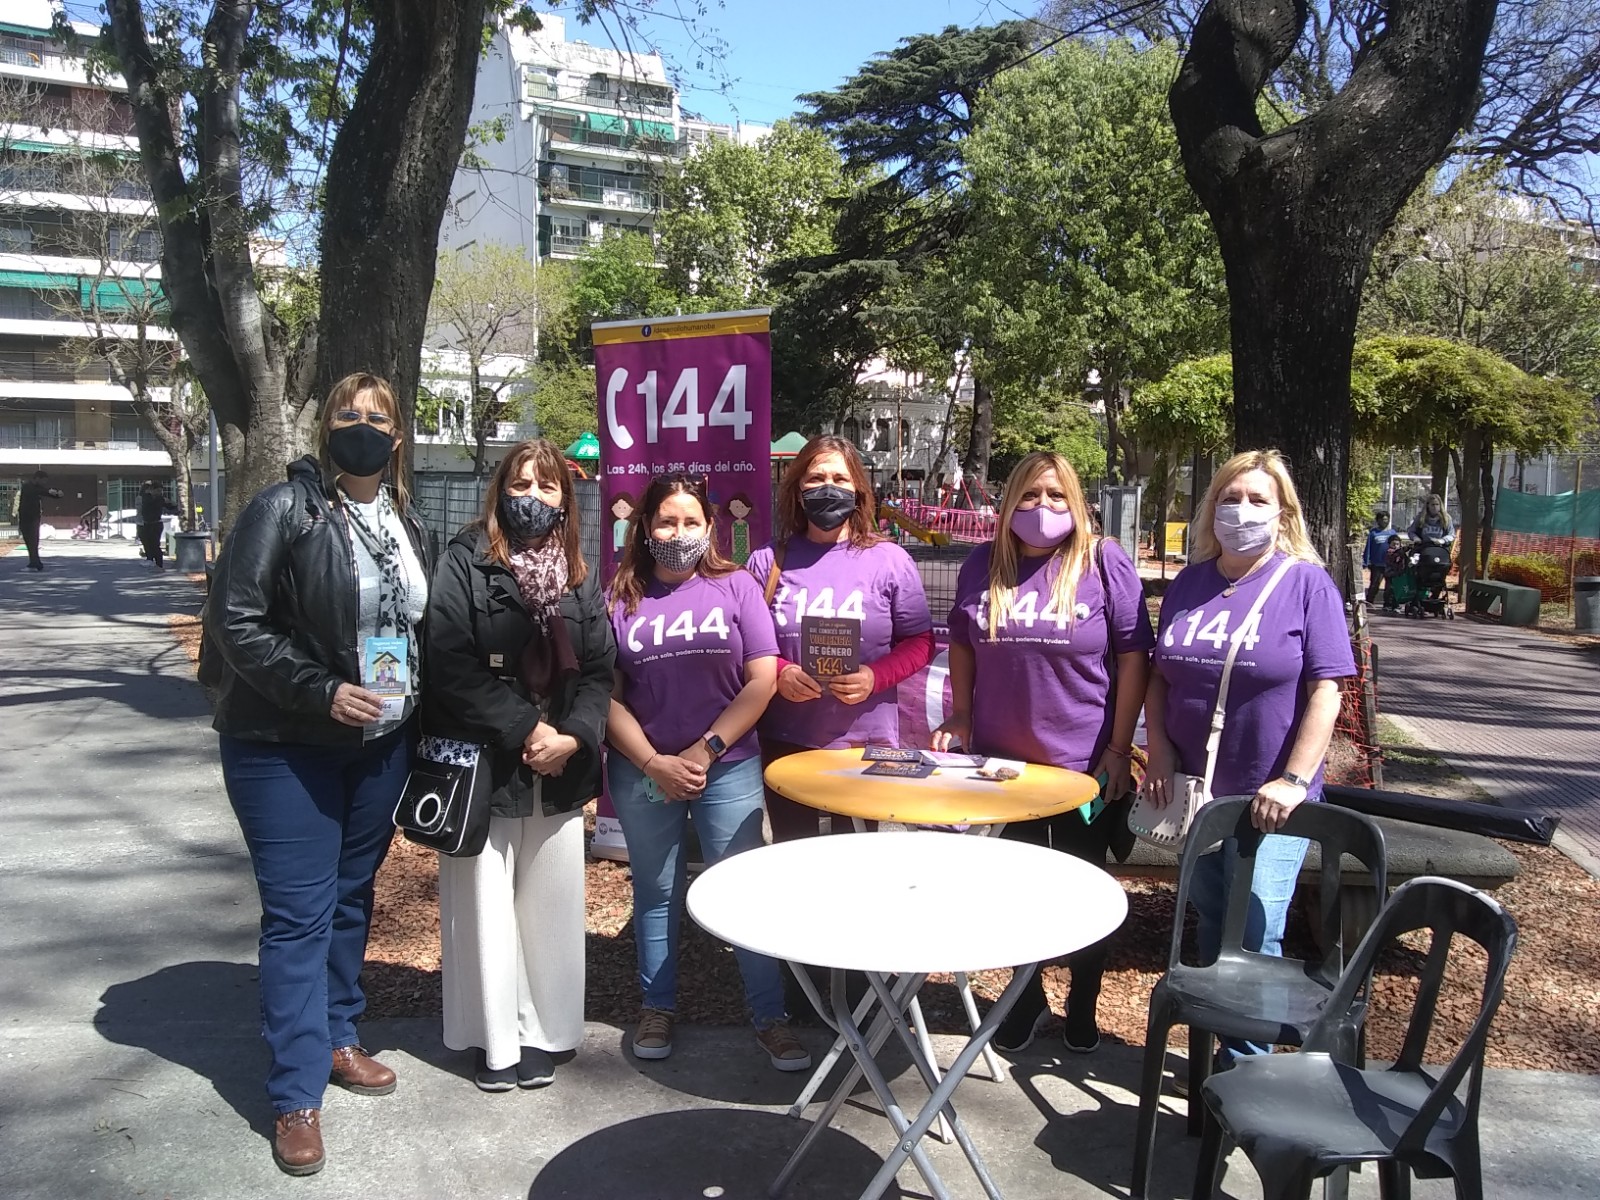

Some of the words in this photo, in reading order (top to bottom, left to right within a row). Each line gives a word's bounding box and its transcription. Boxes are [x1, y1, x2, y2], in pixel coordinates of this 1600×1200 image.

[636, 364, 752, 443] 144
[607, 464, 625, 474] Las
[628, 463, 649, 475] 24h,
[652, 462, 665, 473] los
[668, 462, 685, 473] 365
[688, 461, 711, 473] días
[715, 460, 730, 472] del
[733, 460, 755, 471] año.
[793, 587, 866, 623] 144
[650, 606, 730, 646] 144
[1182, 610, 1263, 650] 144
[675, 648, 704, 657] podemos
[809, 645, 819, 655] DE
[821, 645, 852, 656] GÉNERO
[816, 657, 843, 675] 144
